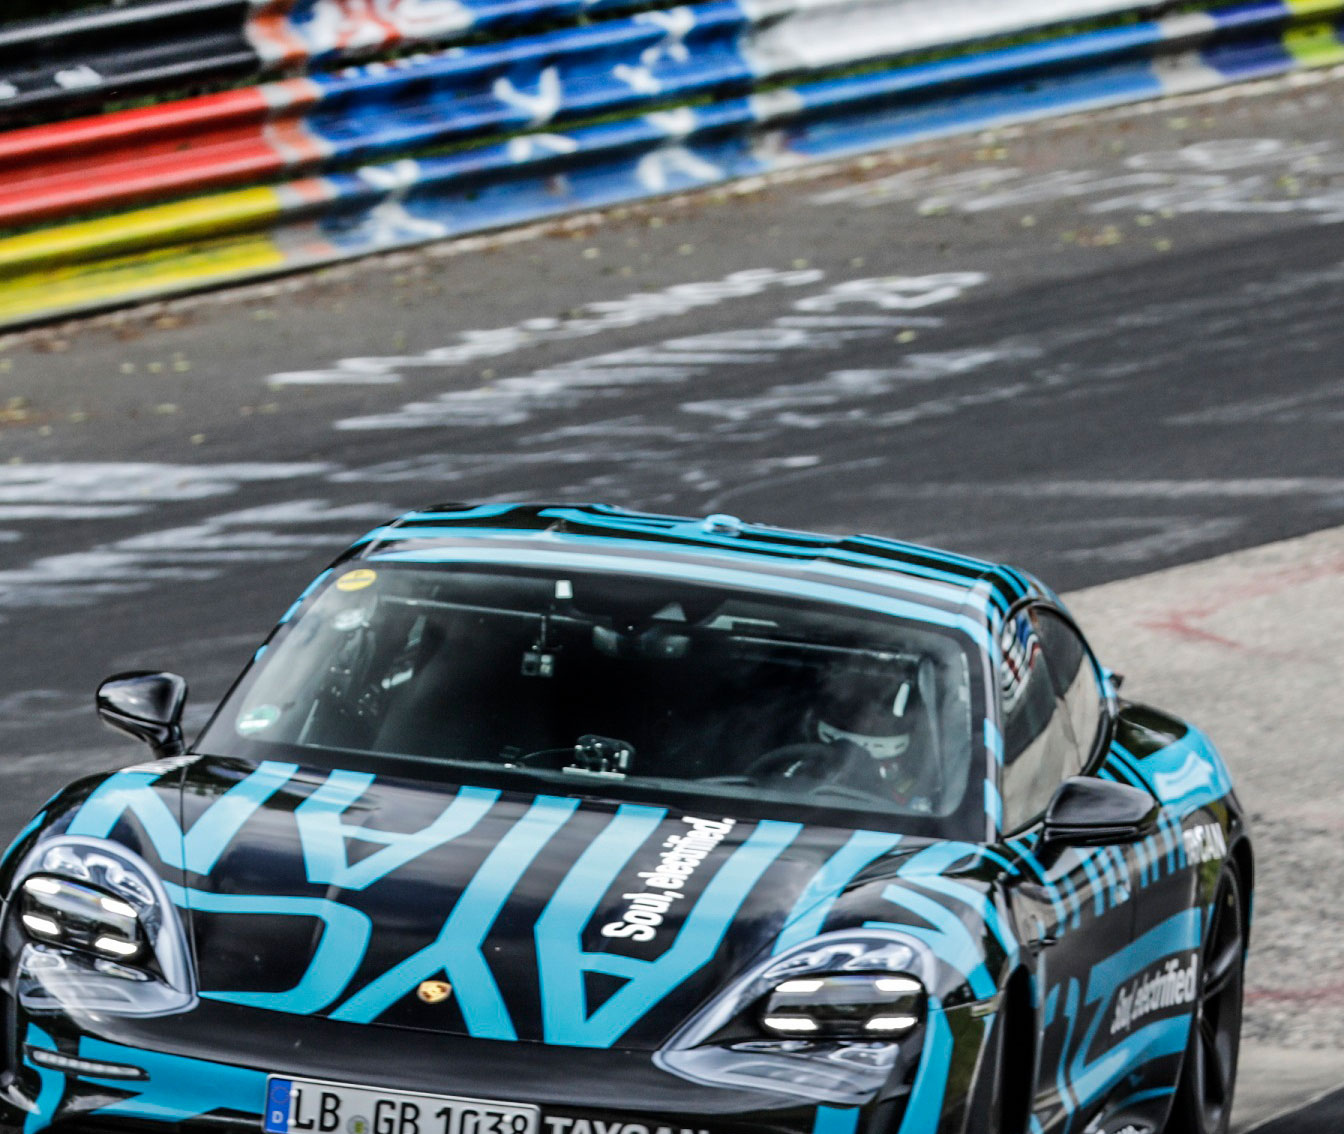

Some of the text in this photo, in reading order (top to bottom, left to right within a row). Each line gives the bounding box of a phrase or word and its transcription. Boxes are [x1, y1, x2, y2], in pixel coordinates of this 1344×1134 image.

[601, 816, 737, 942] Soul, electrified.
[271, 1110, 283, 1125] D
[293, 1088, 342, 1132] LB
